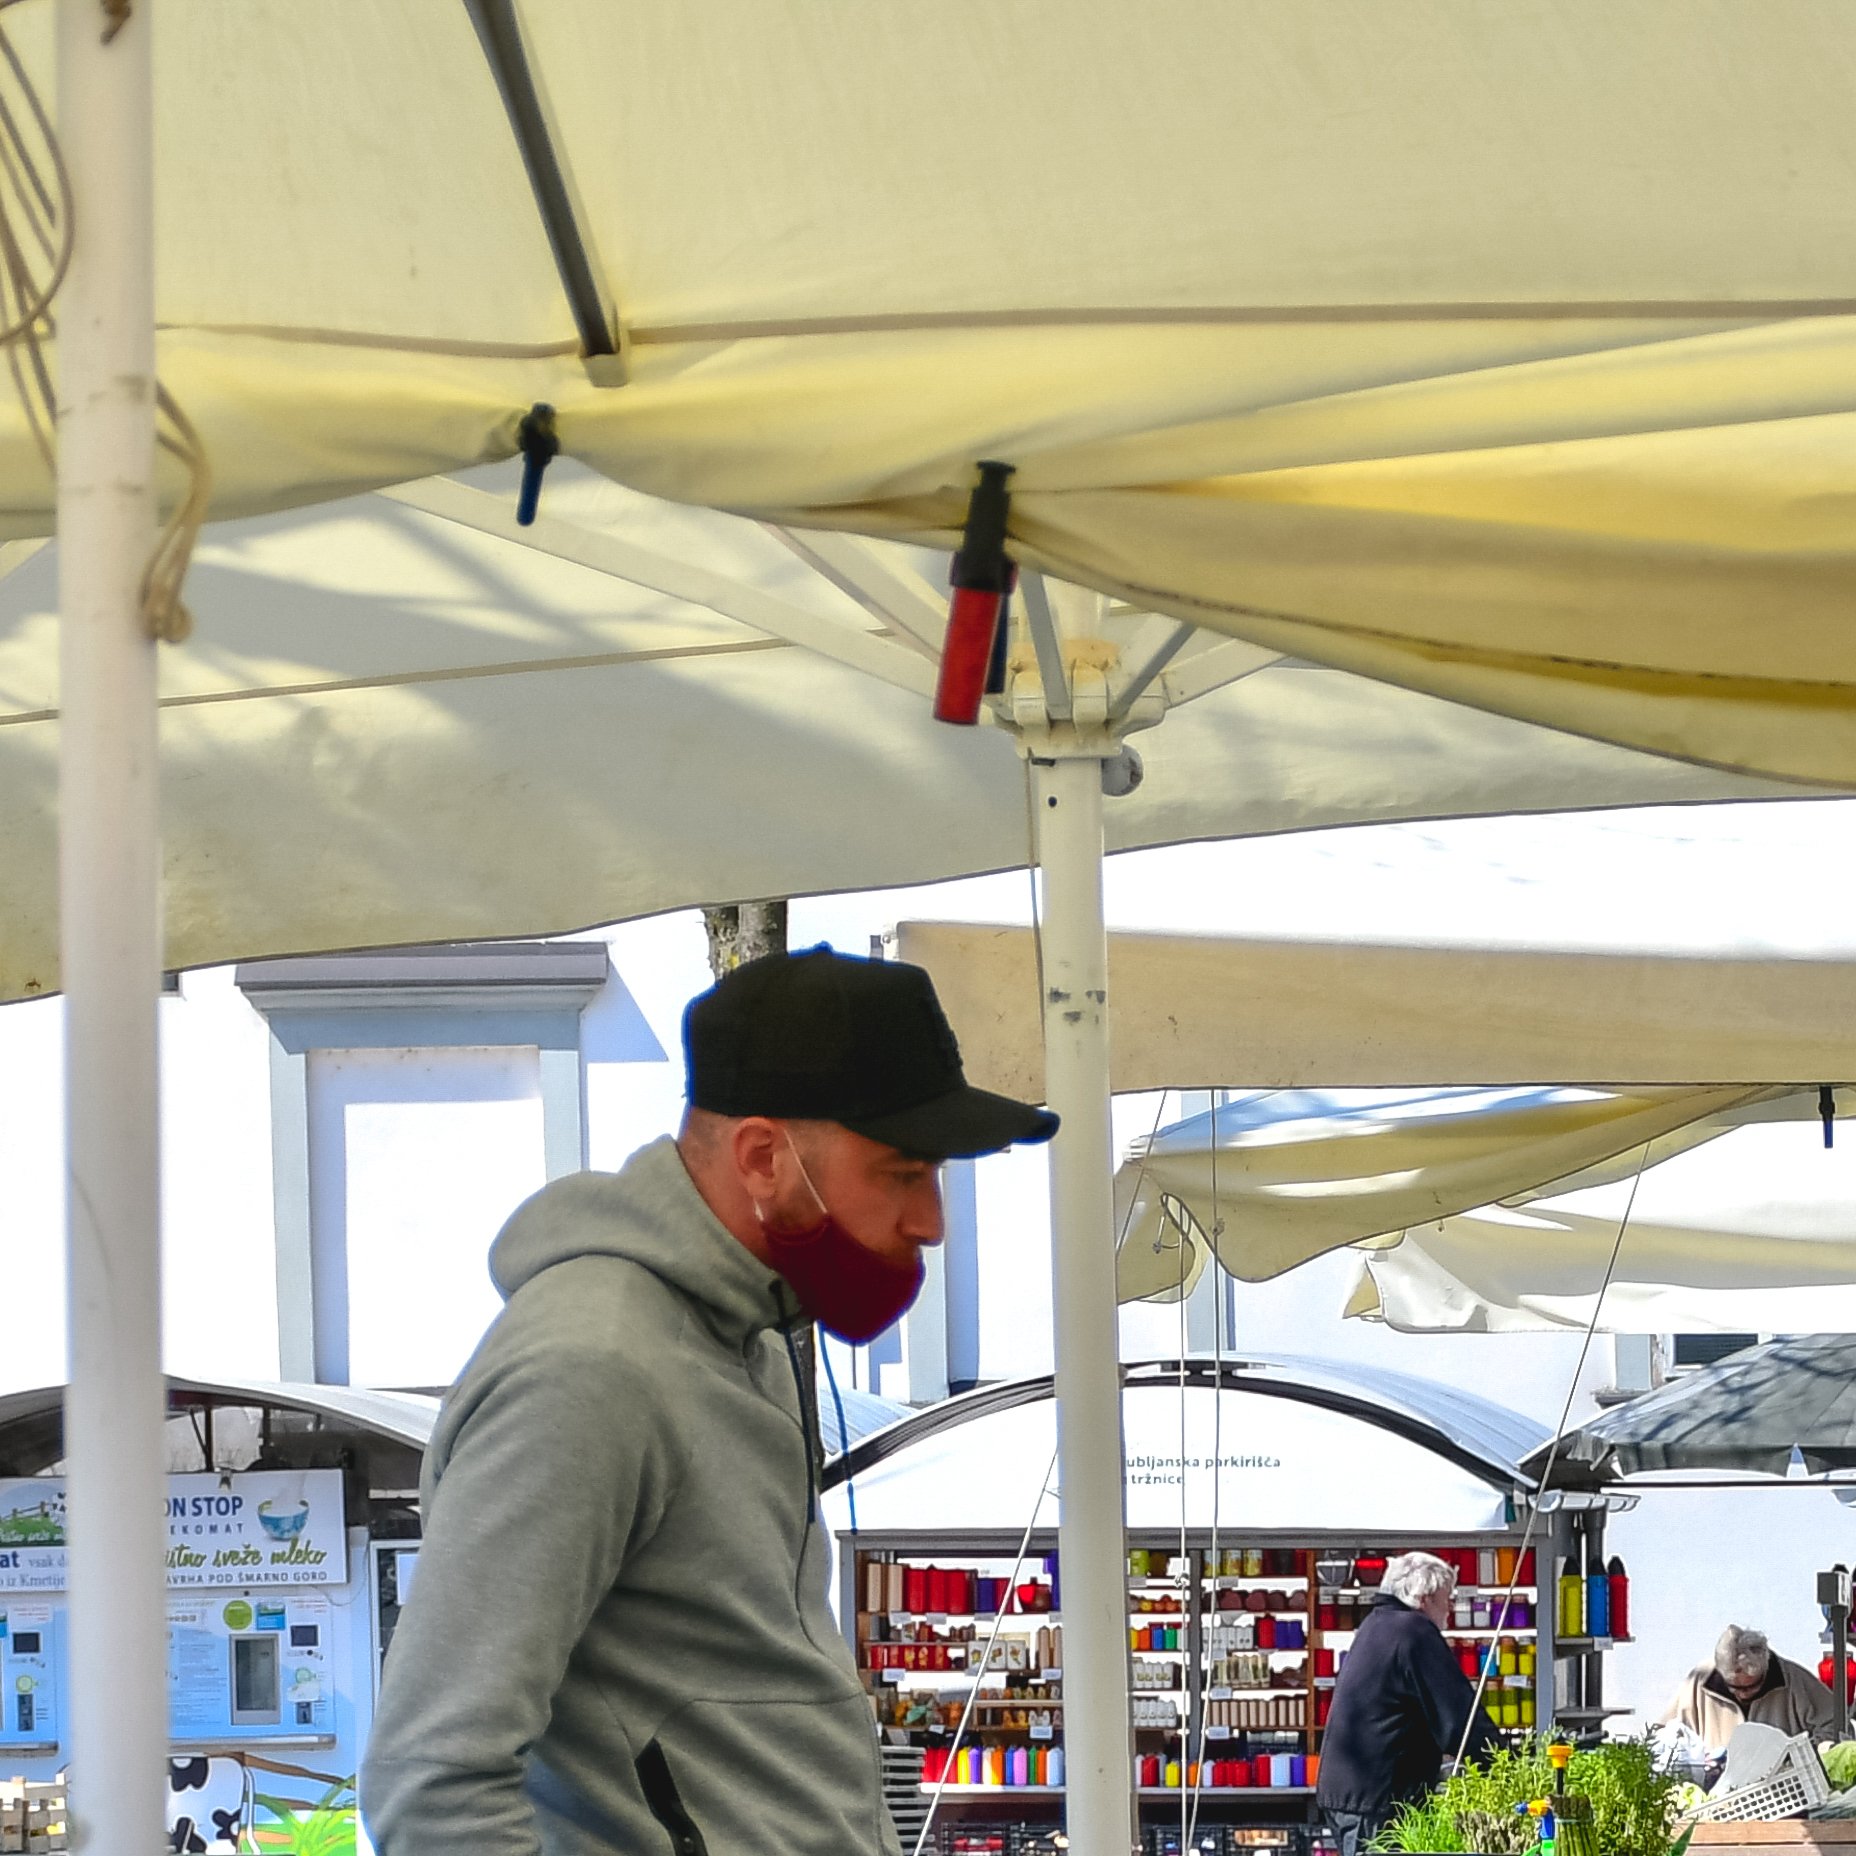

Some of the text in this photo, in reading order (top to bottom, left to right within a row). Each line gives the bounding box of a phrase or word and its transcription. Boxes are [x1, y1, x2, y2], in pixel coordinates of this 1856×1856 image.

[1127, 1455, 1199, 1470] ubljanska
[192, 1496, 243, 1516] STOP
[170, 1522, 243, 1535] EKOMAT
[212, 1543, 263, 1568] sveže
[271, 1536, 327, 1566] mleko
[28, 1554, 54, 1568] vsak
[6, 1575, 16, 1586] iz
[208, 1573, 233, 1584] POD
[237, 1571, 288, 1583] ŠMARNO
